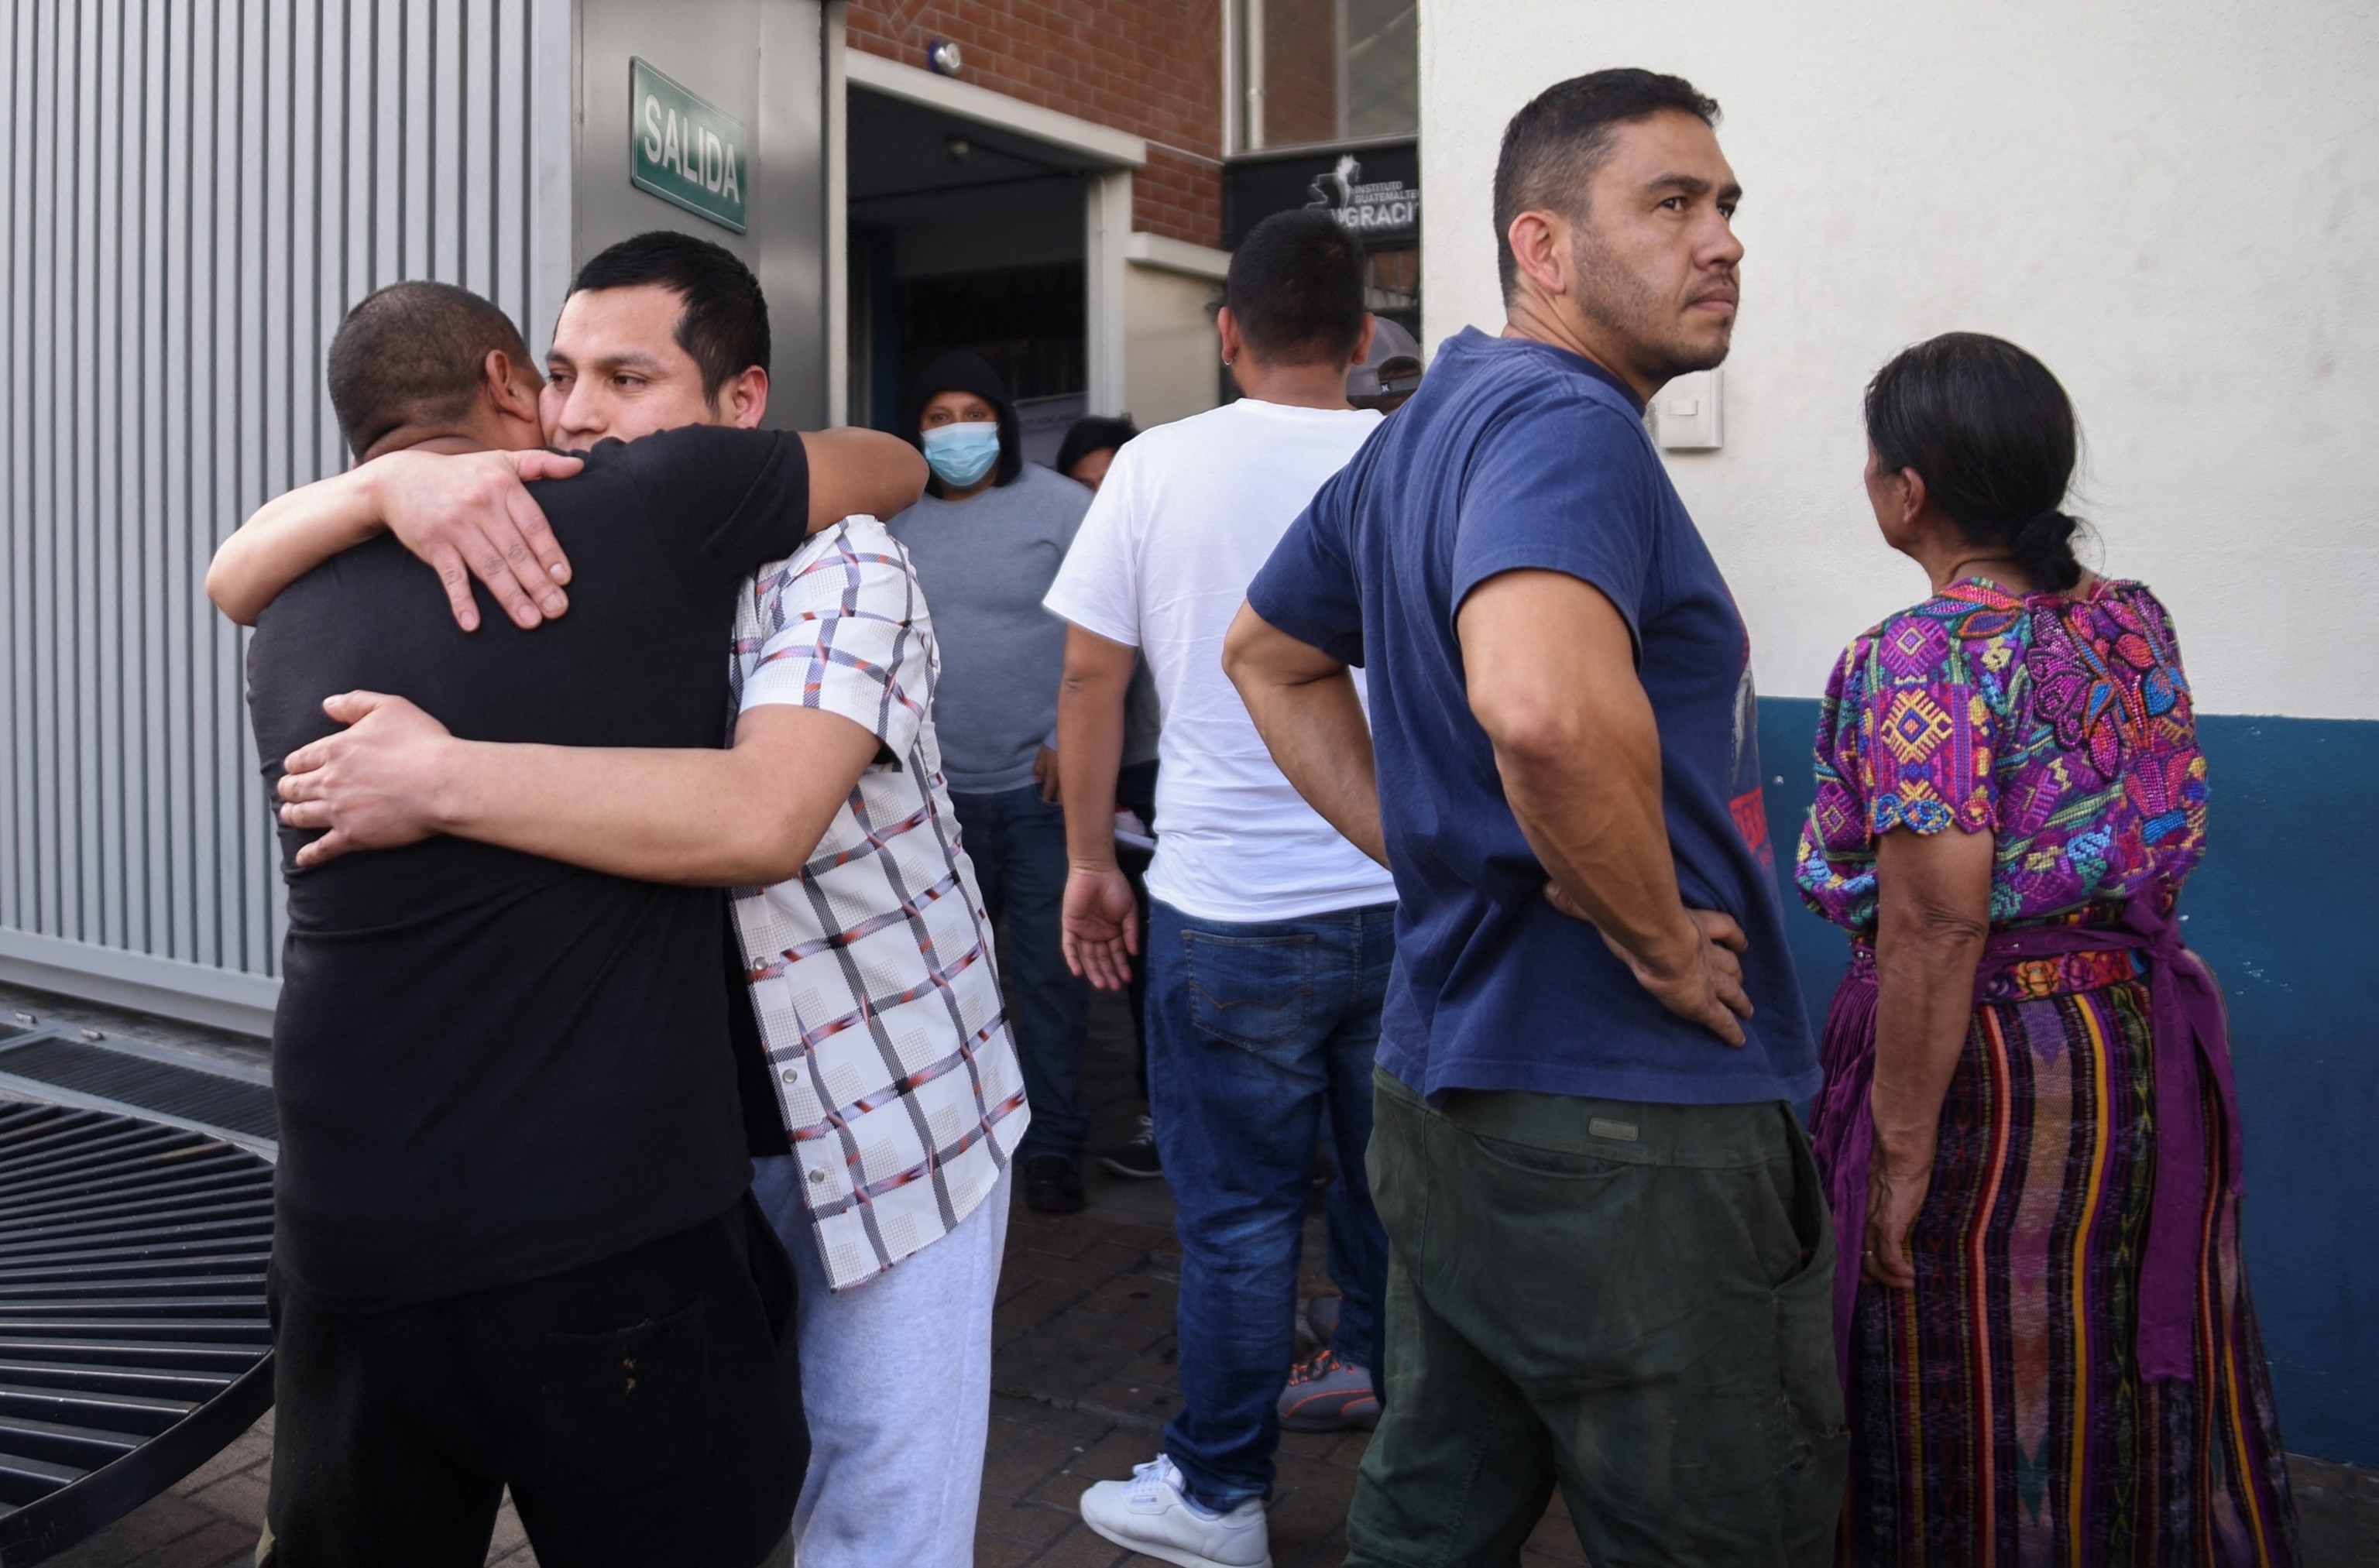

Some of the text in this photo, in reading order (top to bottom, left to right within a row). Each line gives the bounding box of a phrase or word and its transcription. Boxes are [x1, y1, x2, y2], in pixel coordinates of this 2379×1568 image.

[644, 94, 740, 204] SALIDA
[1354, 181, 1402, 194] INSTITUTO
[1354, 189, 1419, 204] GUATEMALTE
